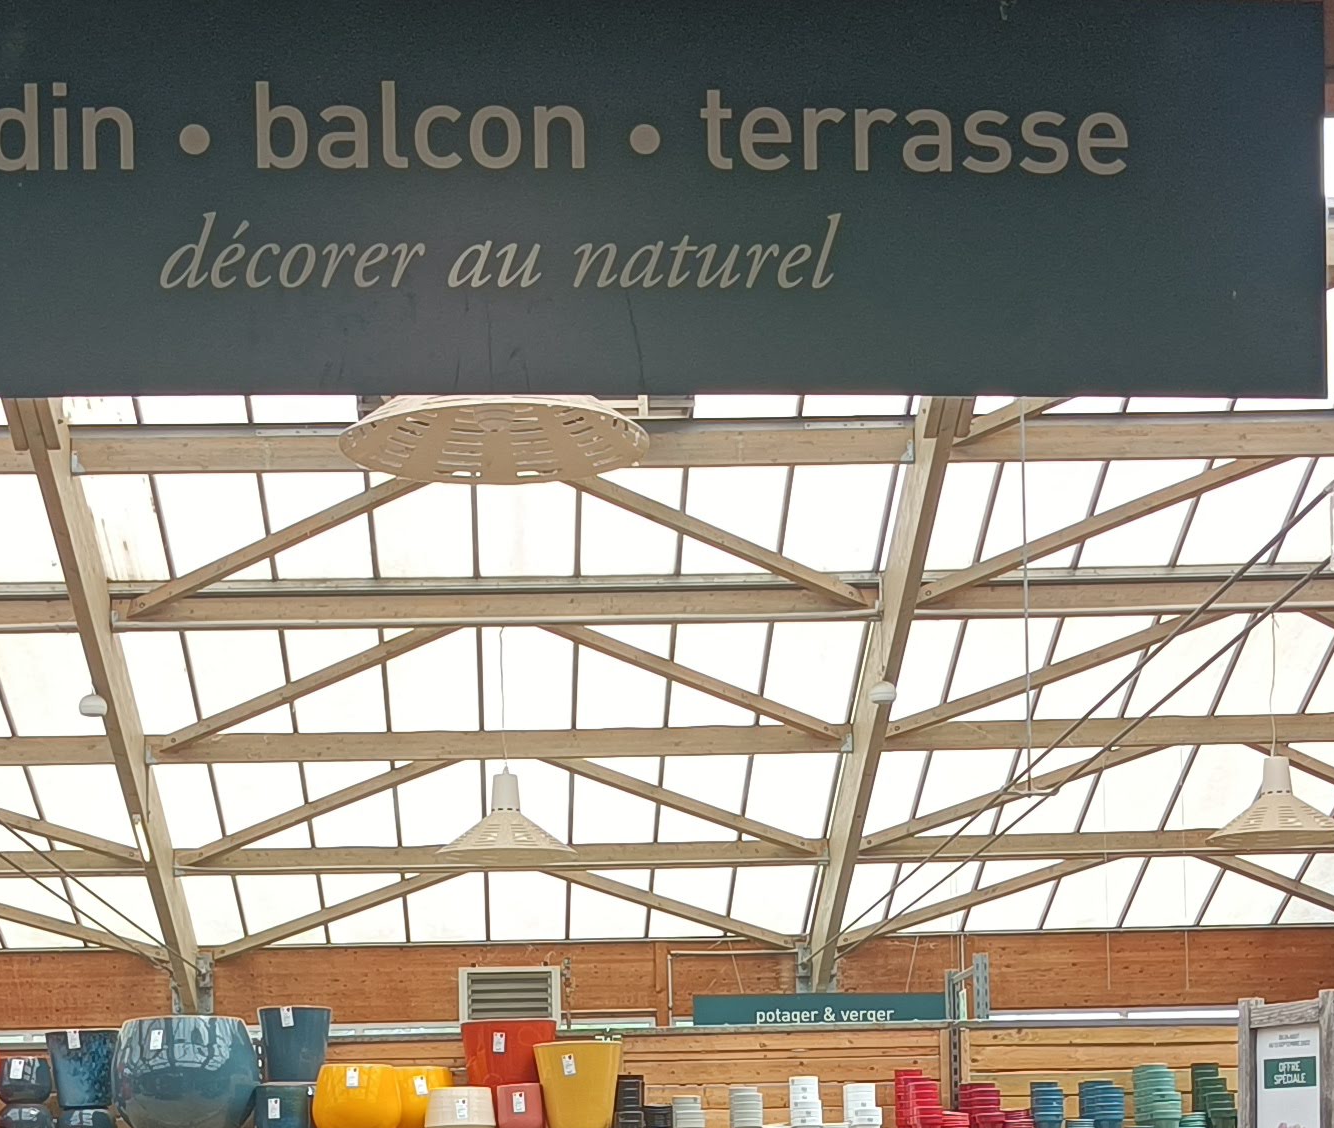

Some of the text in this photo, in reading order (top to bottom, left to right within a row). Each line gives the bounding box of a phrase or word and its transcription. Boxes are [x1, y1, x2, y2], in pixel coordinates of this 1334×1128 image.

[255, 81, 585, 169] balcon
[700, 89, 1128, 175] terrasse
[160, 212, 841, 288] décorer au naturel
[756, 1007, 895, 1024] potager & verger
[1278, 1060, 1302, 1073] OFFRE
